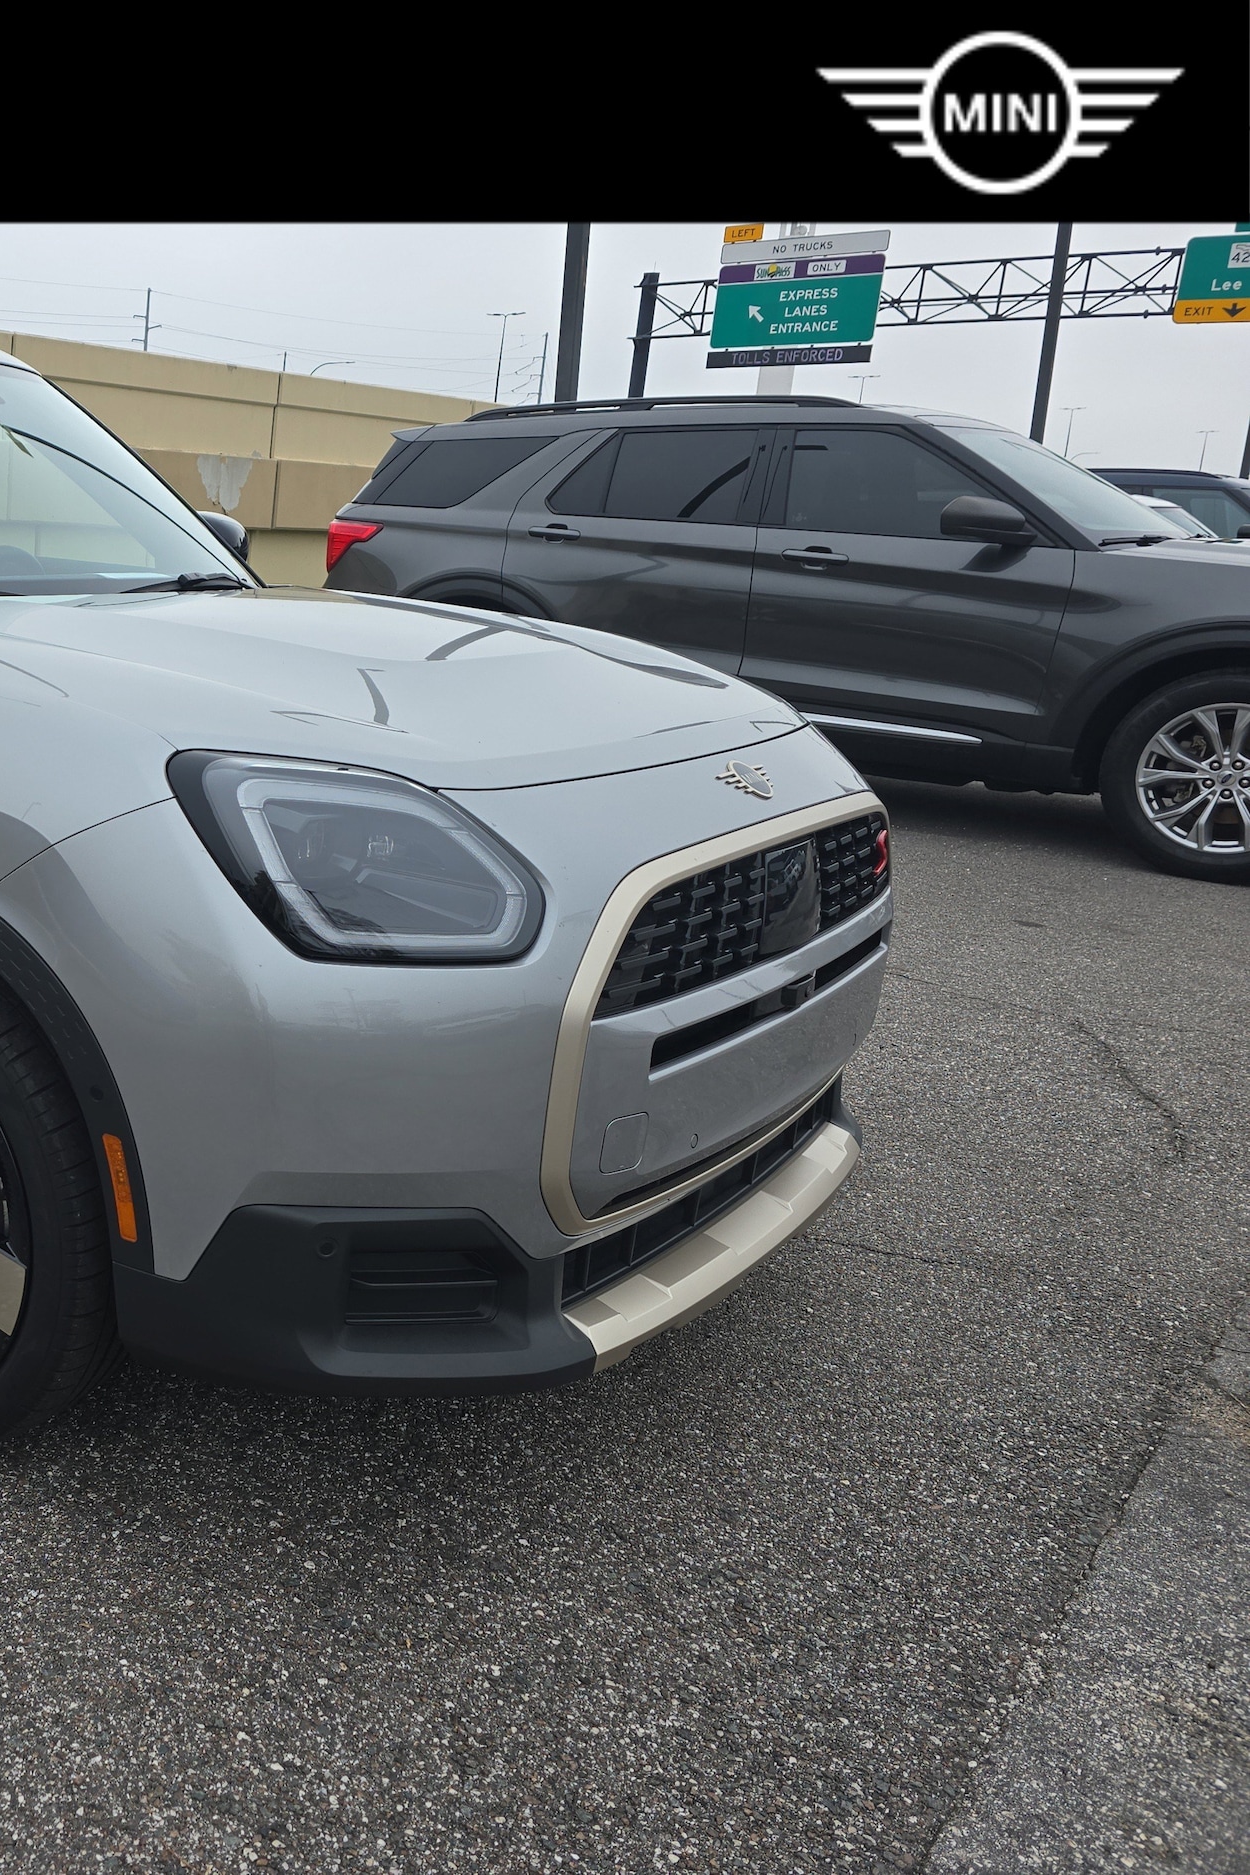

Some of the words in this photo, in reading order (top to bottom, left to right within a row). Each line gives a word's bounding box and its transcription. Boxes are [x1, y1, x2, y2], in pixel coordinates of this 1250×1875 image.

[731, 228, 756, 239] LEFT
[772, 244, 787, 254] NO
[793, 240, 833, 252] TRUCKS
[812, 262, 842, 273] ONLY
[1211, 278, 1243, 292] Lee
[779, 287, 839, 302] EXPRESS
[784, 305, 828, 318] LANES
[1184, 306, 1215, 317] EXIT
[769, 320, 839, 335] ENTRANCE
[731, 351, 770, 366] TOLLS
[775, 348, 843, 364] ENFORCED
